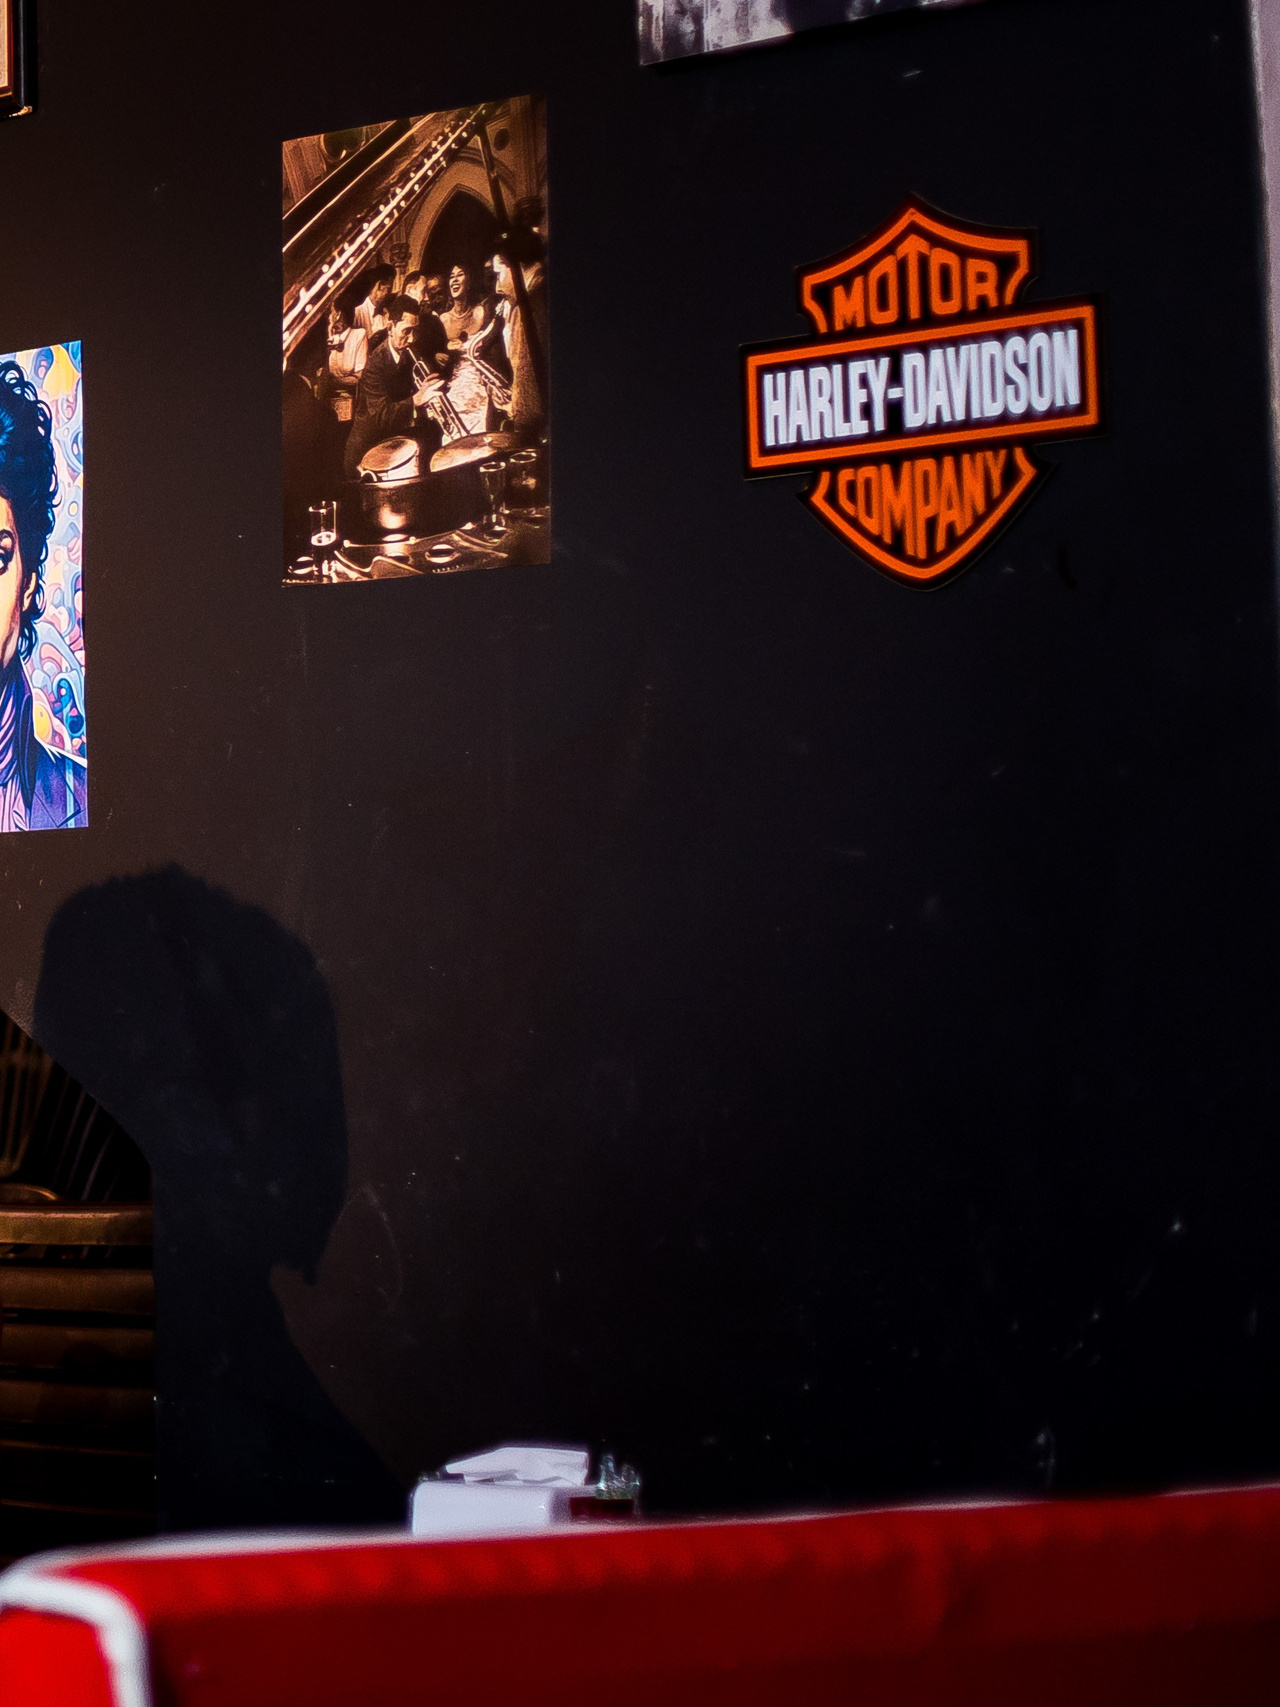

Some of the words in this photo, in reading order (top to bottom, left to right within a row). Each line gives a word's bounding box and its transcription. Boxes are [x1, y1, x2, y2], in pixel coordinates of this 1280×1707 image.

[833, 233, 999, 332] MOTOR
[763, 329, 1081, 447] HARLEY-DAVIDSON
[837, 448, 1008, 559] COMPANY
